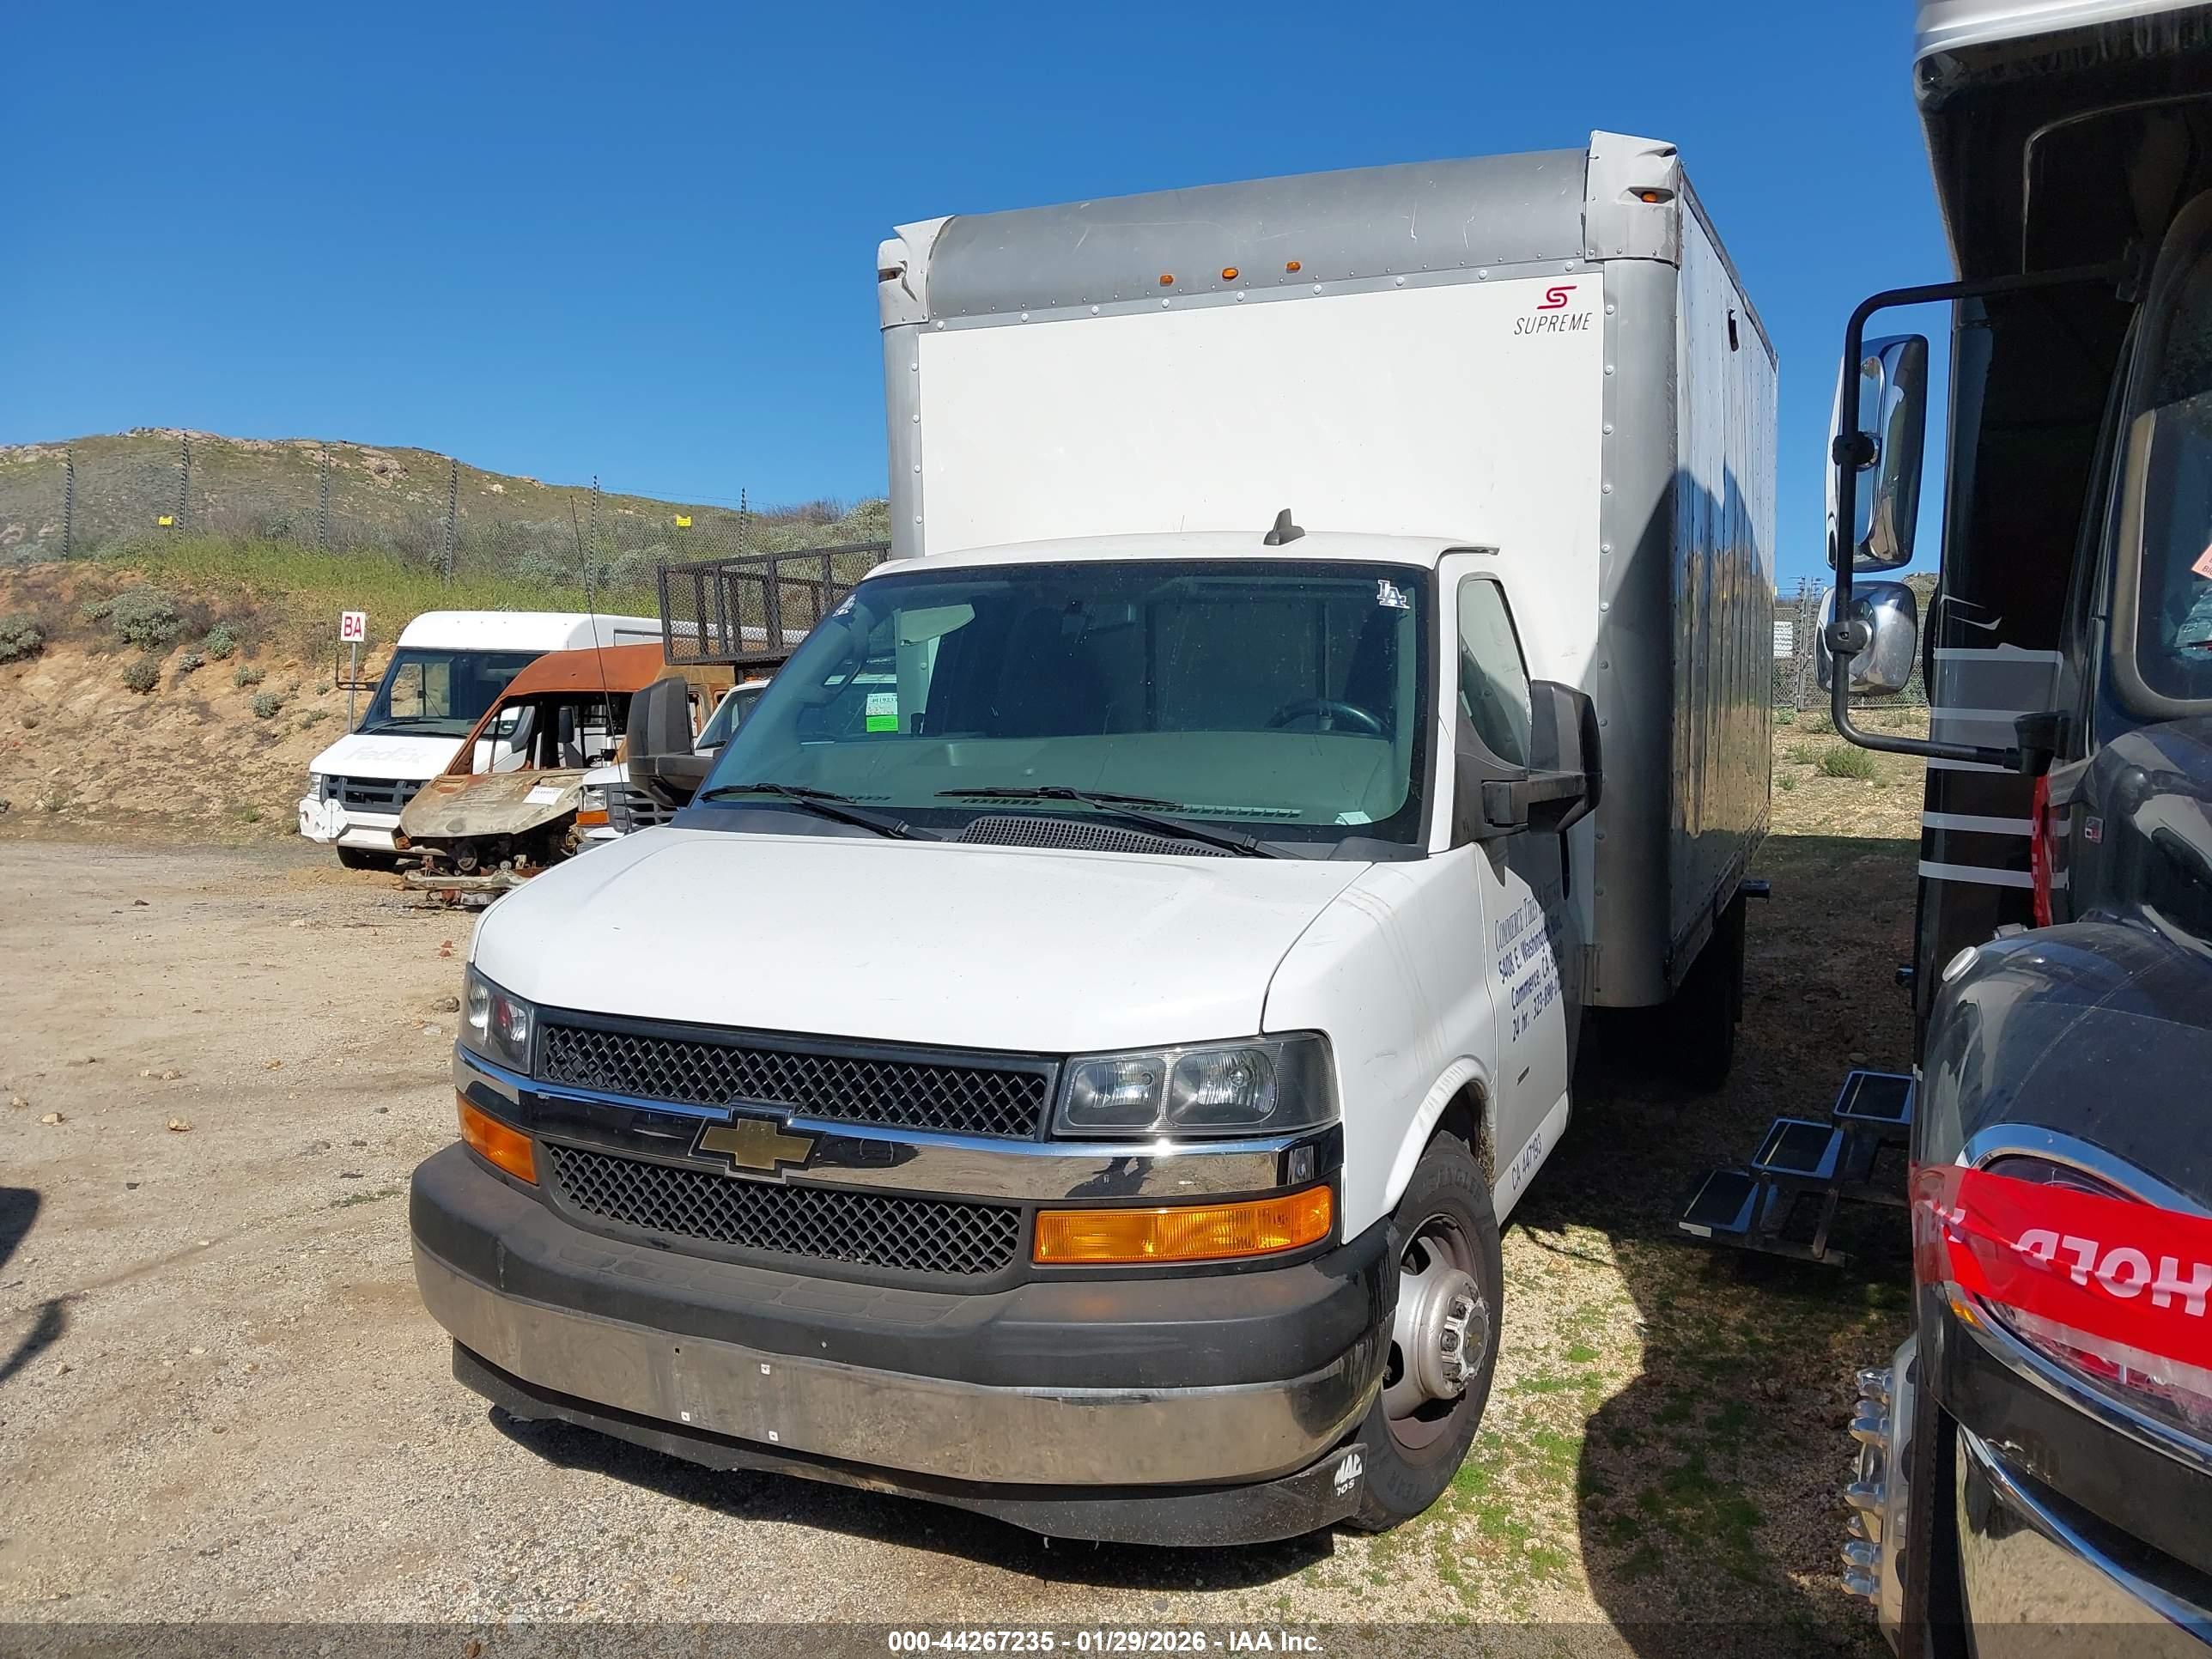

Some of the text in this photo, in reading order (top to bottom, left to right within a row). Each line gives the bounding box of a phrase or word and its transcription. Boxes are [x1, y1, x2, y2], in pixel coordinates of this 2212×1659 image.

[1514, 312, 1593, 336] SUPREME
[343, 616, 362, 637] BA
[1498, 951, 1516, 985] 5408
[1520, 925, 1553, 963] Washington
[1541, 954, 1551, 979] CA
[1513, 1014, 1520, 1043] 24
[1511, 1161, 1522, 1191] CA
[2014, 1229, 2212, 1317] HOLD
